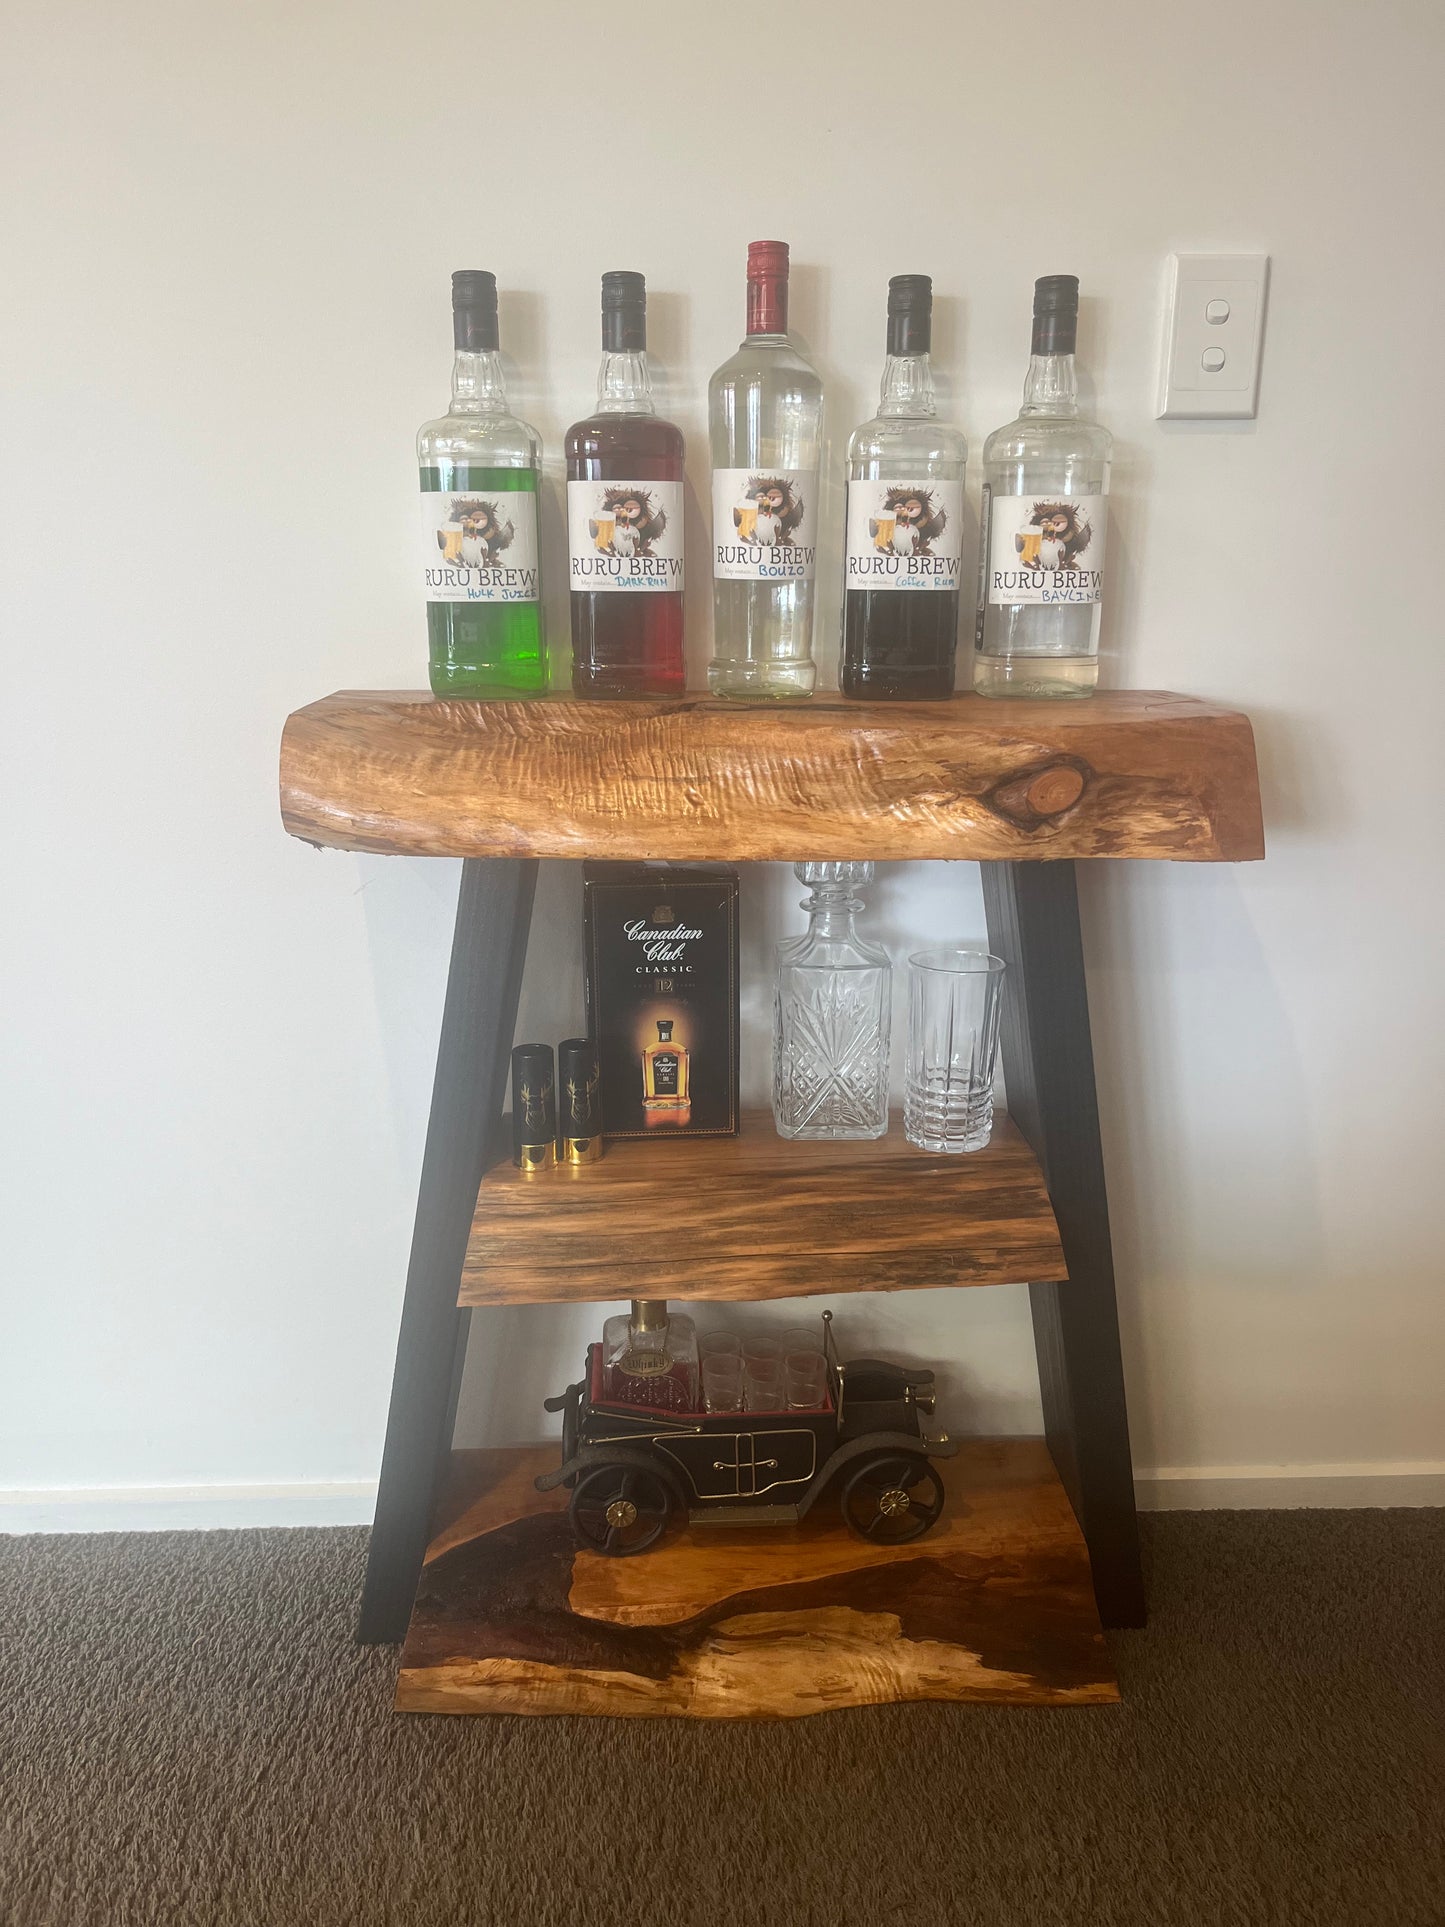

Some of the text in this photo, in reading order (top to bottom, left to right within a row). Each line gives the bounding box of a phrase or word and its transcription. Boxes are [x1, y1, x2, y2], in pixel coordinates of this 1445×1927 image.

[717, 546, 815, 565] RURU BREW
[572, 557, 683, 576] RURU BREW
[849, 556, 960, 575] RURU BREW
[425, 568, 536, 586] RURU BREW
[615, 576, 646, 587] DARK
[896, 575, 927, 587] Coffee
[934, 576, 955, 587] Rum
[994, 571, 1103, 589] RURU BREW
[467, 588, 494, 599] HULK
[502, 588, 537, 600] JUICE
[623, 919, 704, 941] Canadian
[635, 965, 693, 974] CLASSIC
[659, 980, 673, 992] 12
